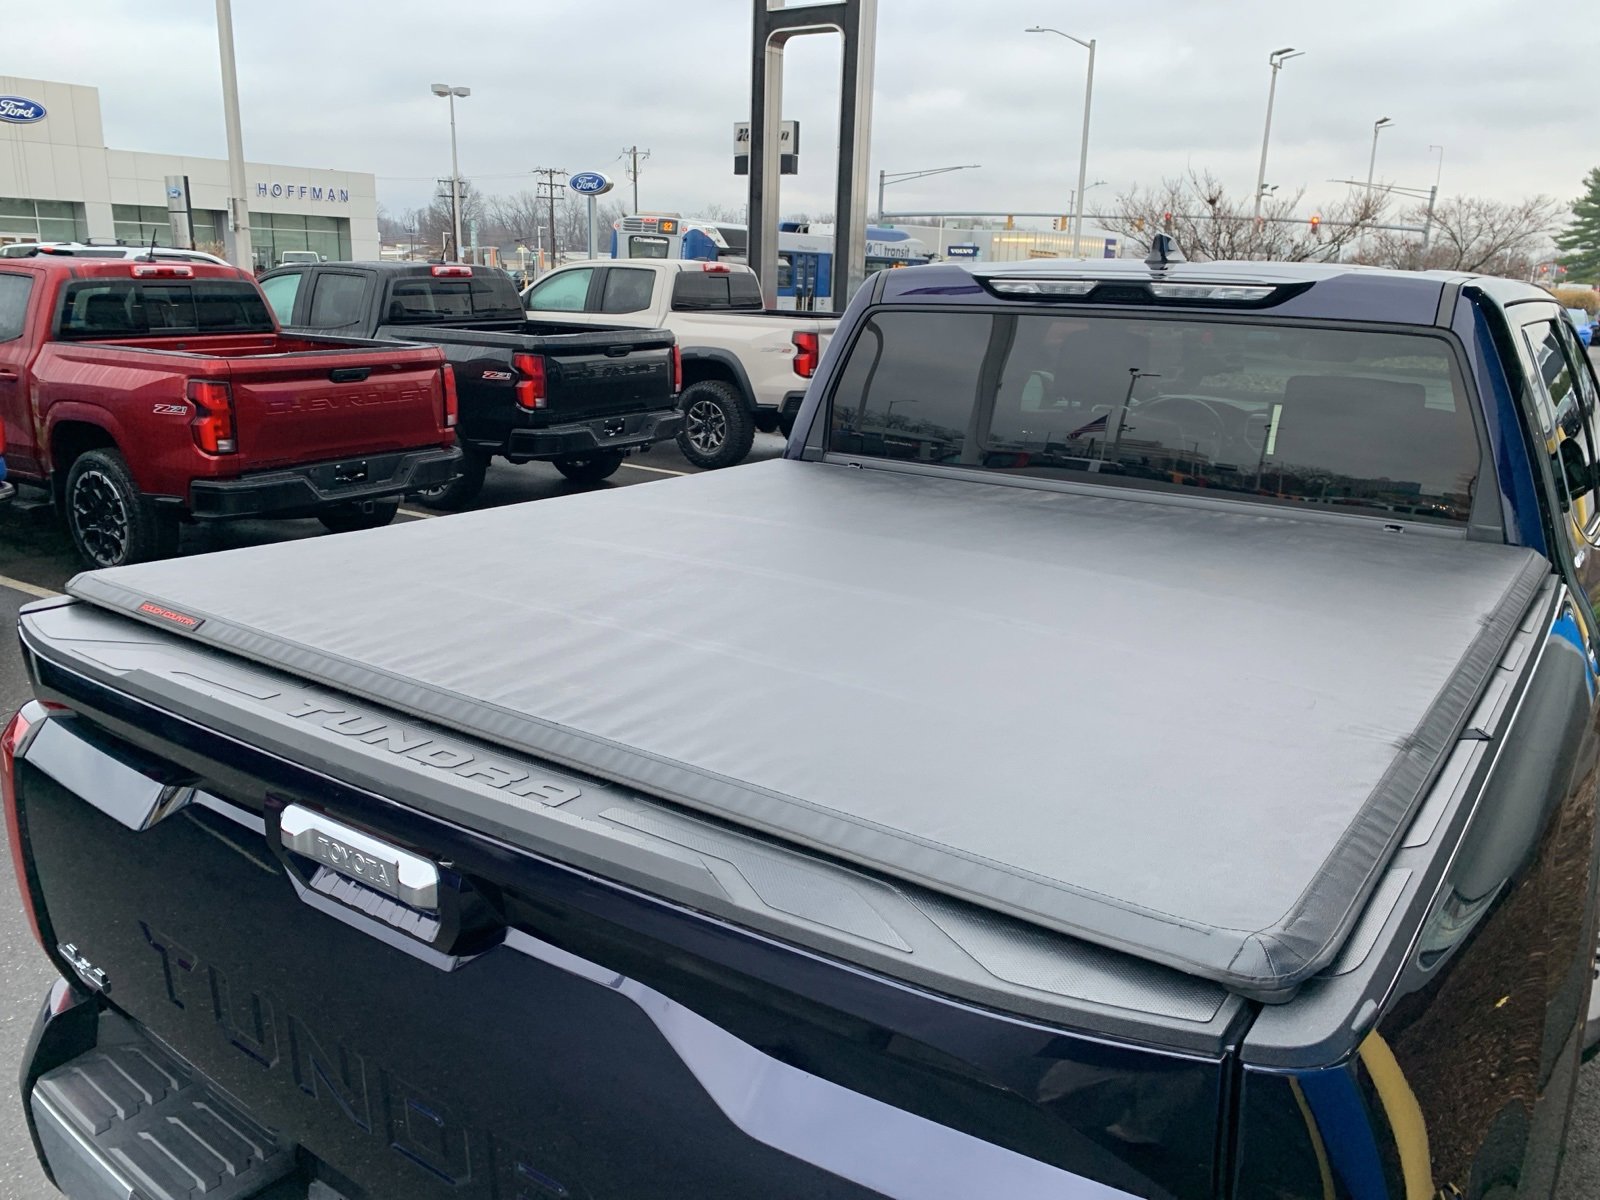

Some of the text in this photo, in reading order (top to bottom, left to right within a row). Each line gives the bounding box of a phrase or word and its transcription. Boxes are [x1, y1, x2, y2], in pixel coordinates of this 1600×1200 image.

[0, 100, 35, 118] Ford
[576, 176, 599, 190] Ford
[256, 182, 349, 202] HOFFMAN
[884, 244, 910, 258] transit
[950, 247, 974, 255] VOLVO
[265, 385, 431, 416] CHEVROLET
[152, 403, 188, 416] Z71
[162, 609, 199, 626] COUNTRY
[285, 701, 582, 808] TUNDRA
[317, 836, 391, 888] TOYOTA
